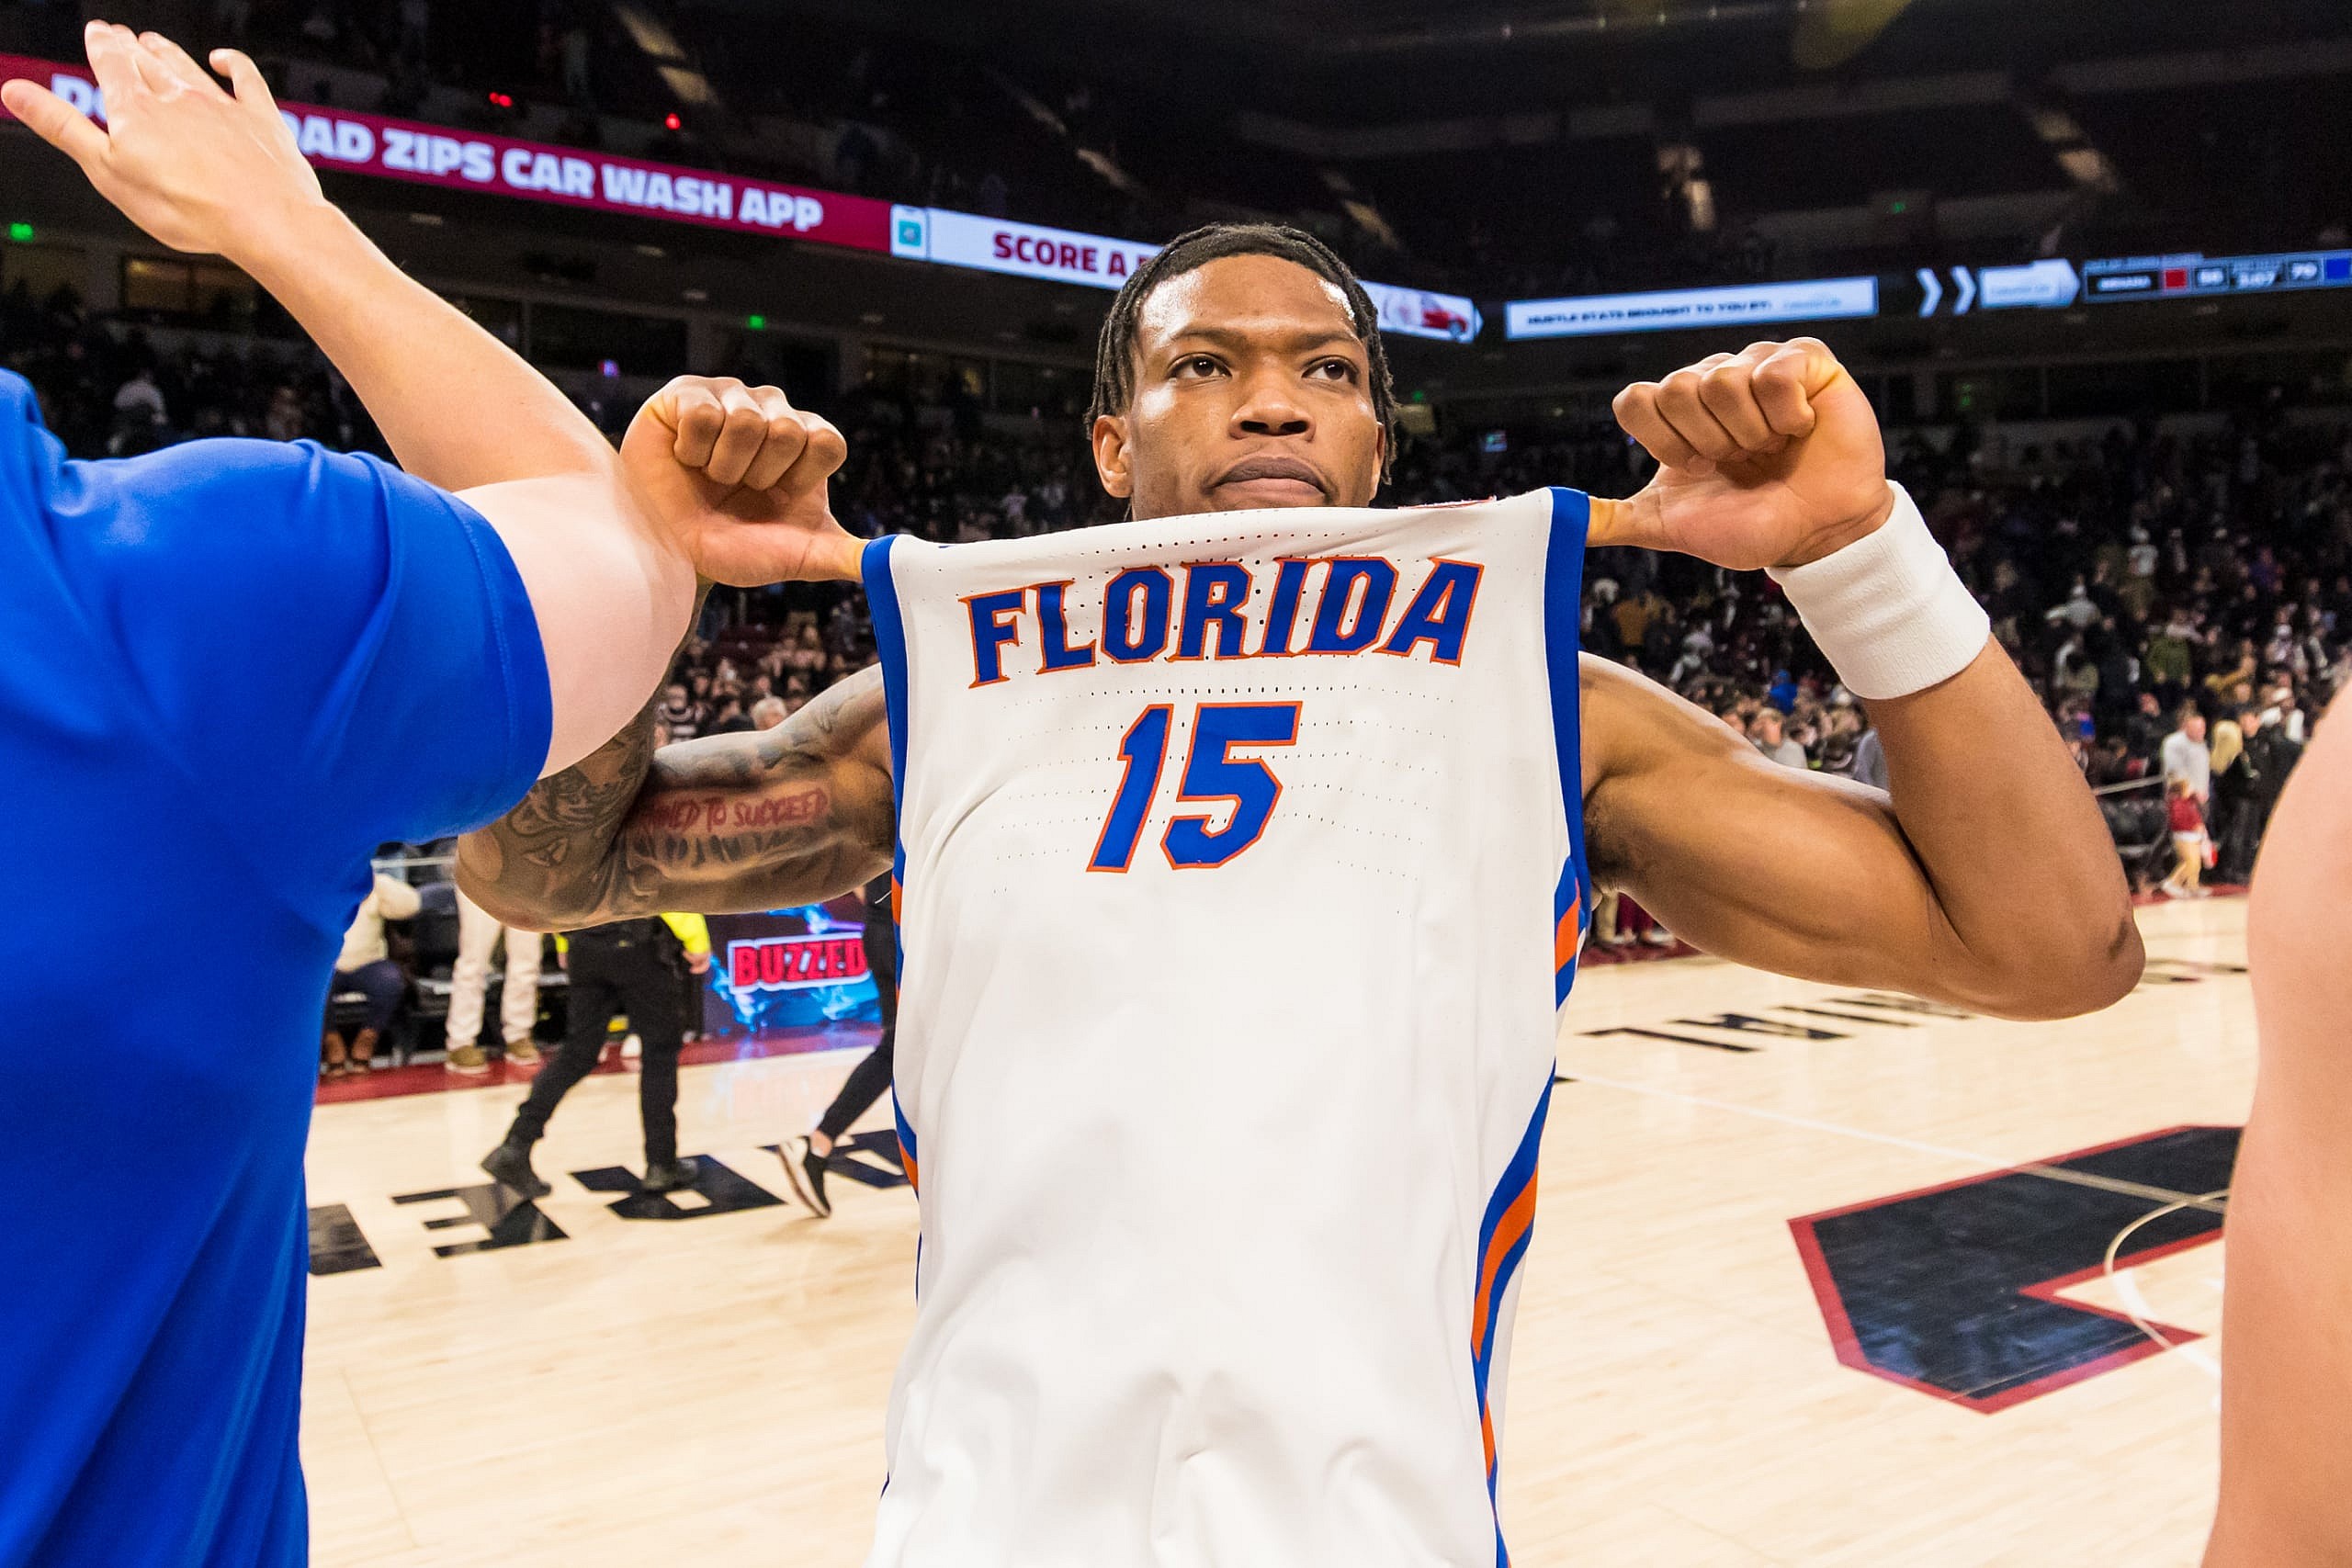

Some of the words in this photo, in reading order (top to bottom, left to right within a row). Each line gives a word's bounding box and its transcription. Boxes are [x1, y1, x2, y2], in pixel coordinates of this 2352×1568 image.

[382, 129, 494, 181] ZIPS
[502, 149, 594, 198] CAR
[601, 164, 732, 219] WASH
[739, 187, 823, 231] APP
[994, 231, 1098, 273] SCORE
[1108, 253, 1127, 276] A
[959, 555, 1486, 689] FLORIDA
[1086, 700, 1303, 874] 15
[733, 938, 868, 987] BUZZED
